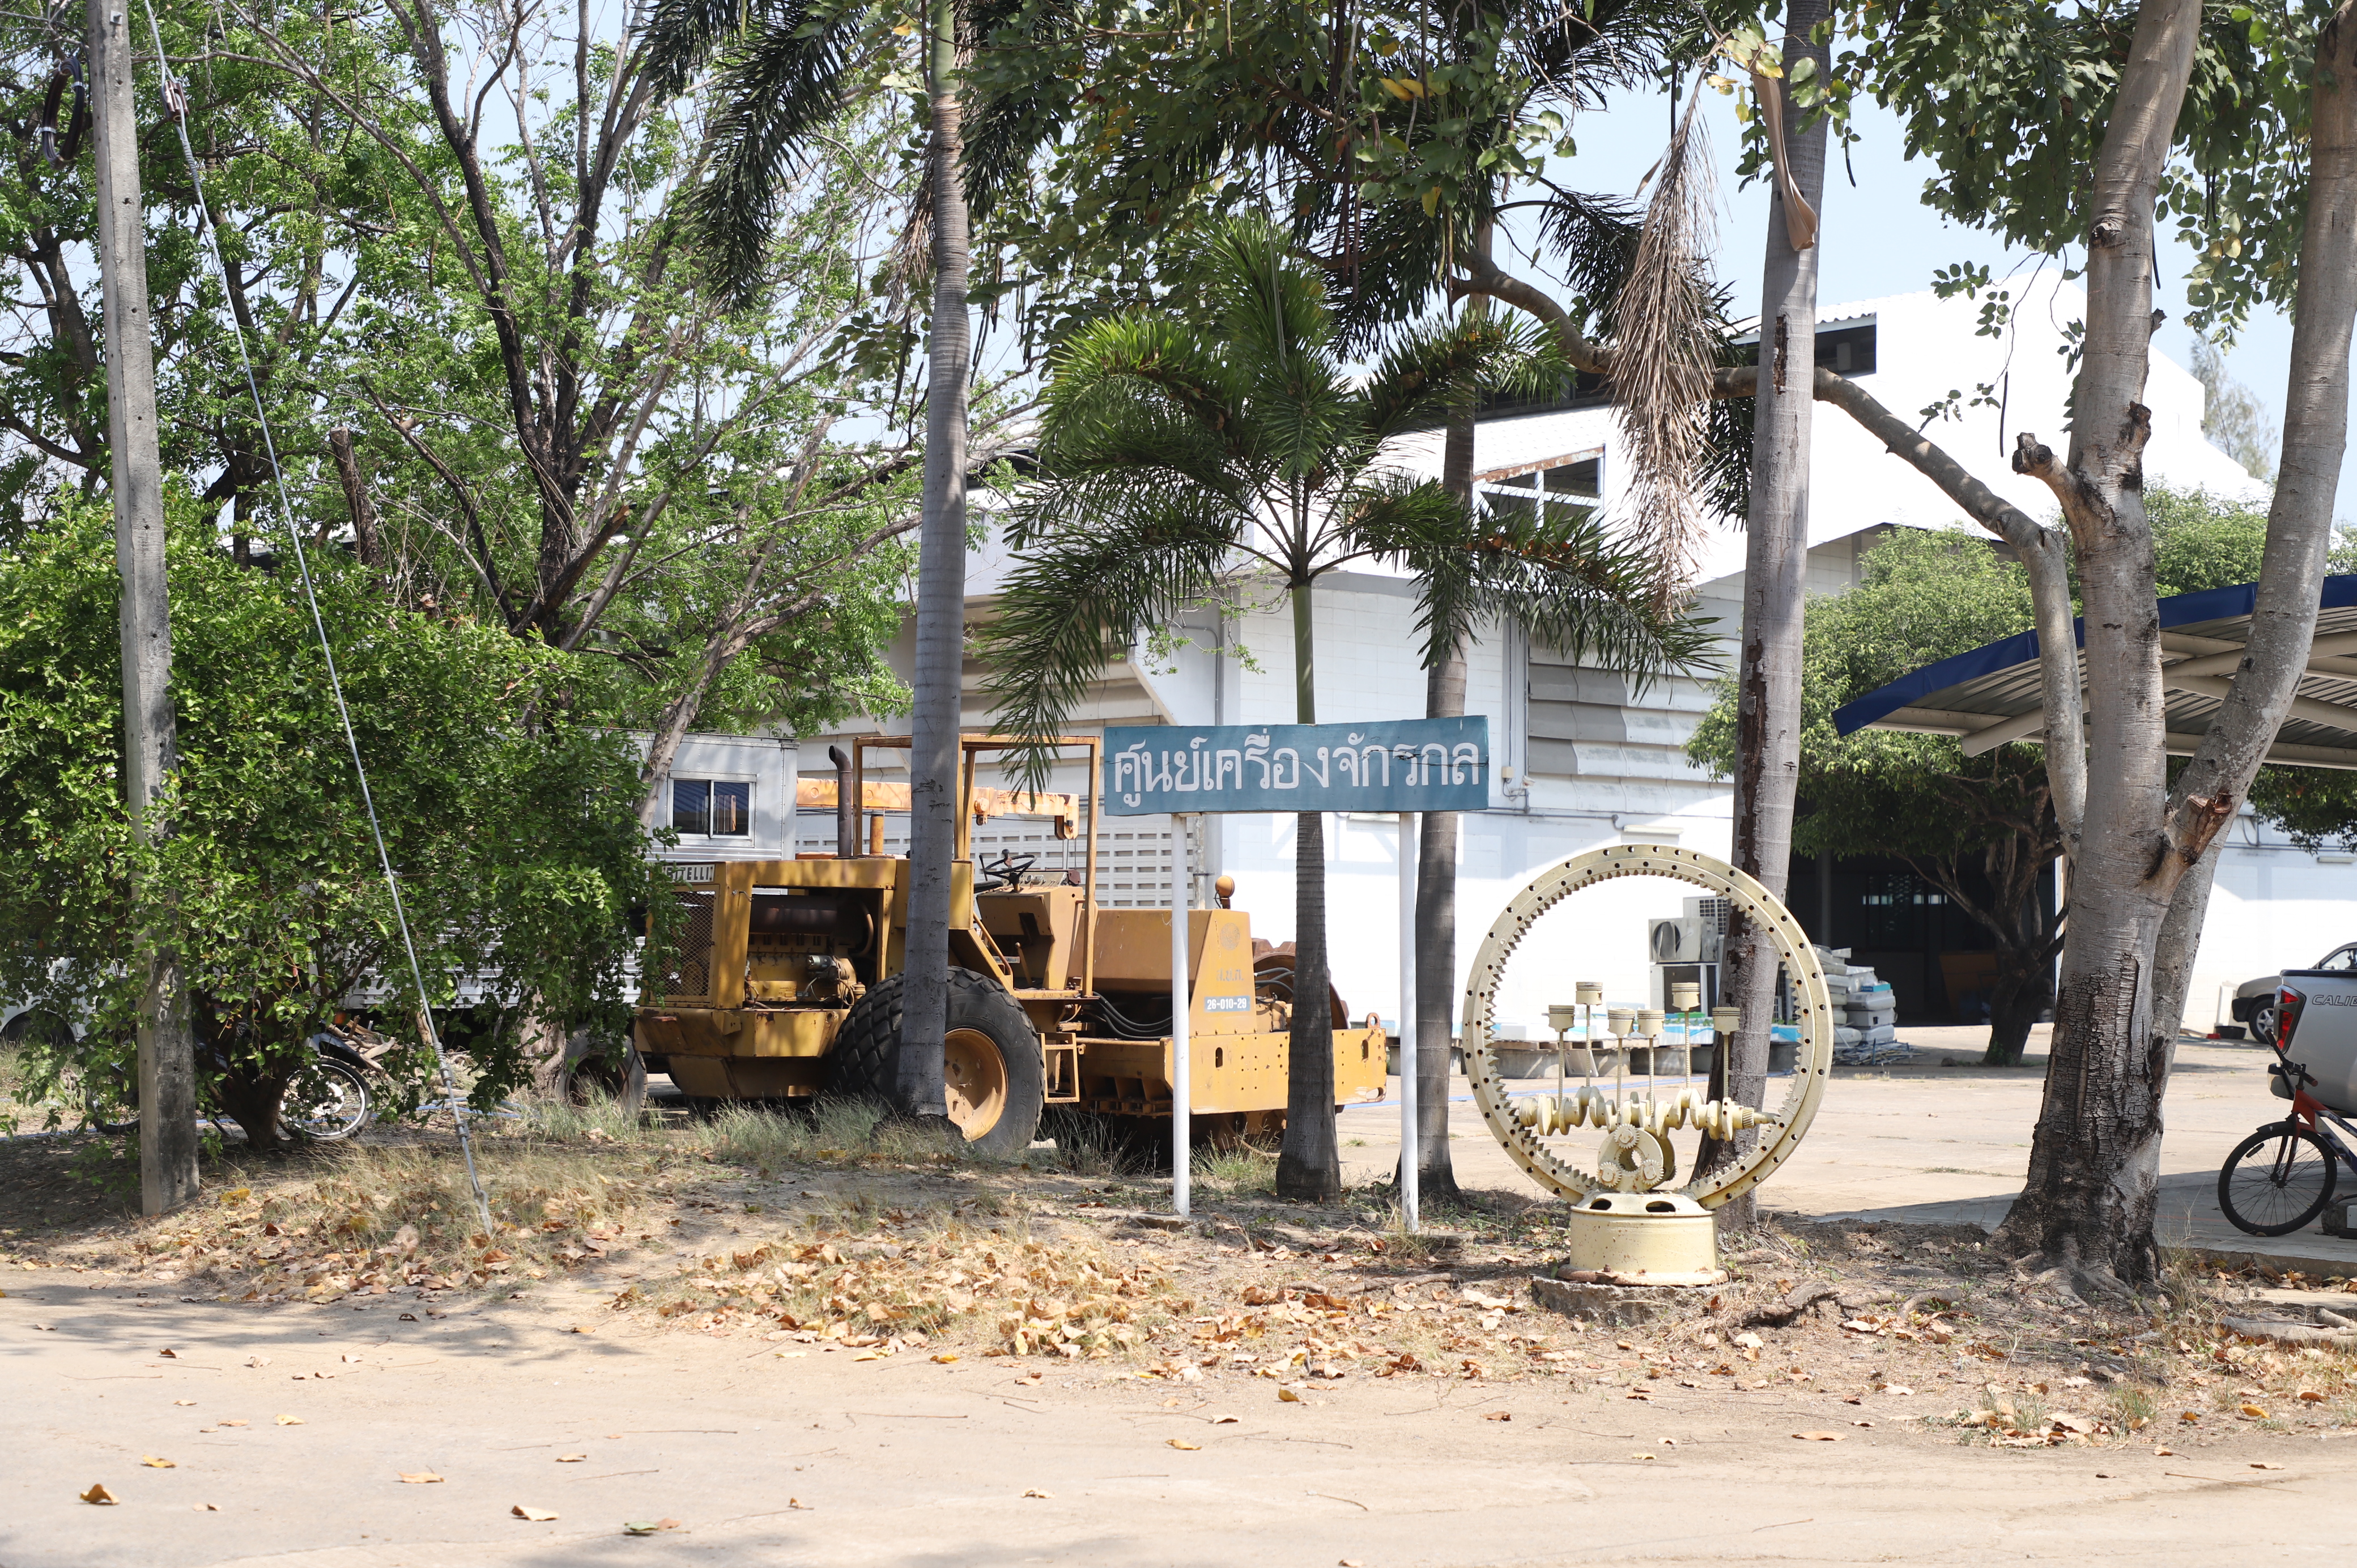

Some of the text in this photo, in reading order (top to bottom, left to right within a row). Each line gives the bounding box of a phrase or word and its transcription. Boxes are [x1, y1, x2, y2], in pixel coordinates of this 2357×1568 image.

[1115, 728, 1479, 807] ศูนย์เครื่องจักรกล
[666, 867, 709, 880] BITELLI
[1207, 998, 1247, 1010] 26-010-29
